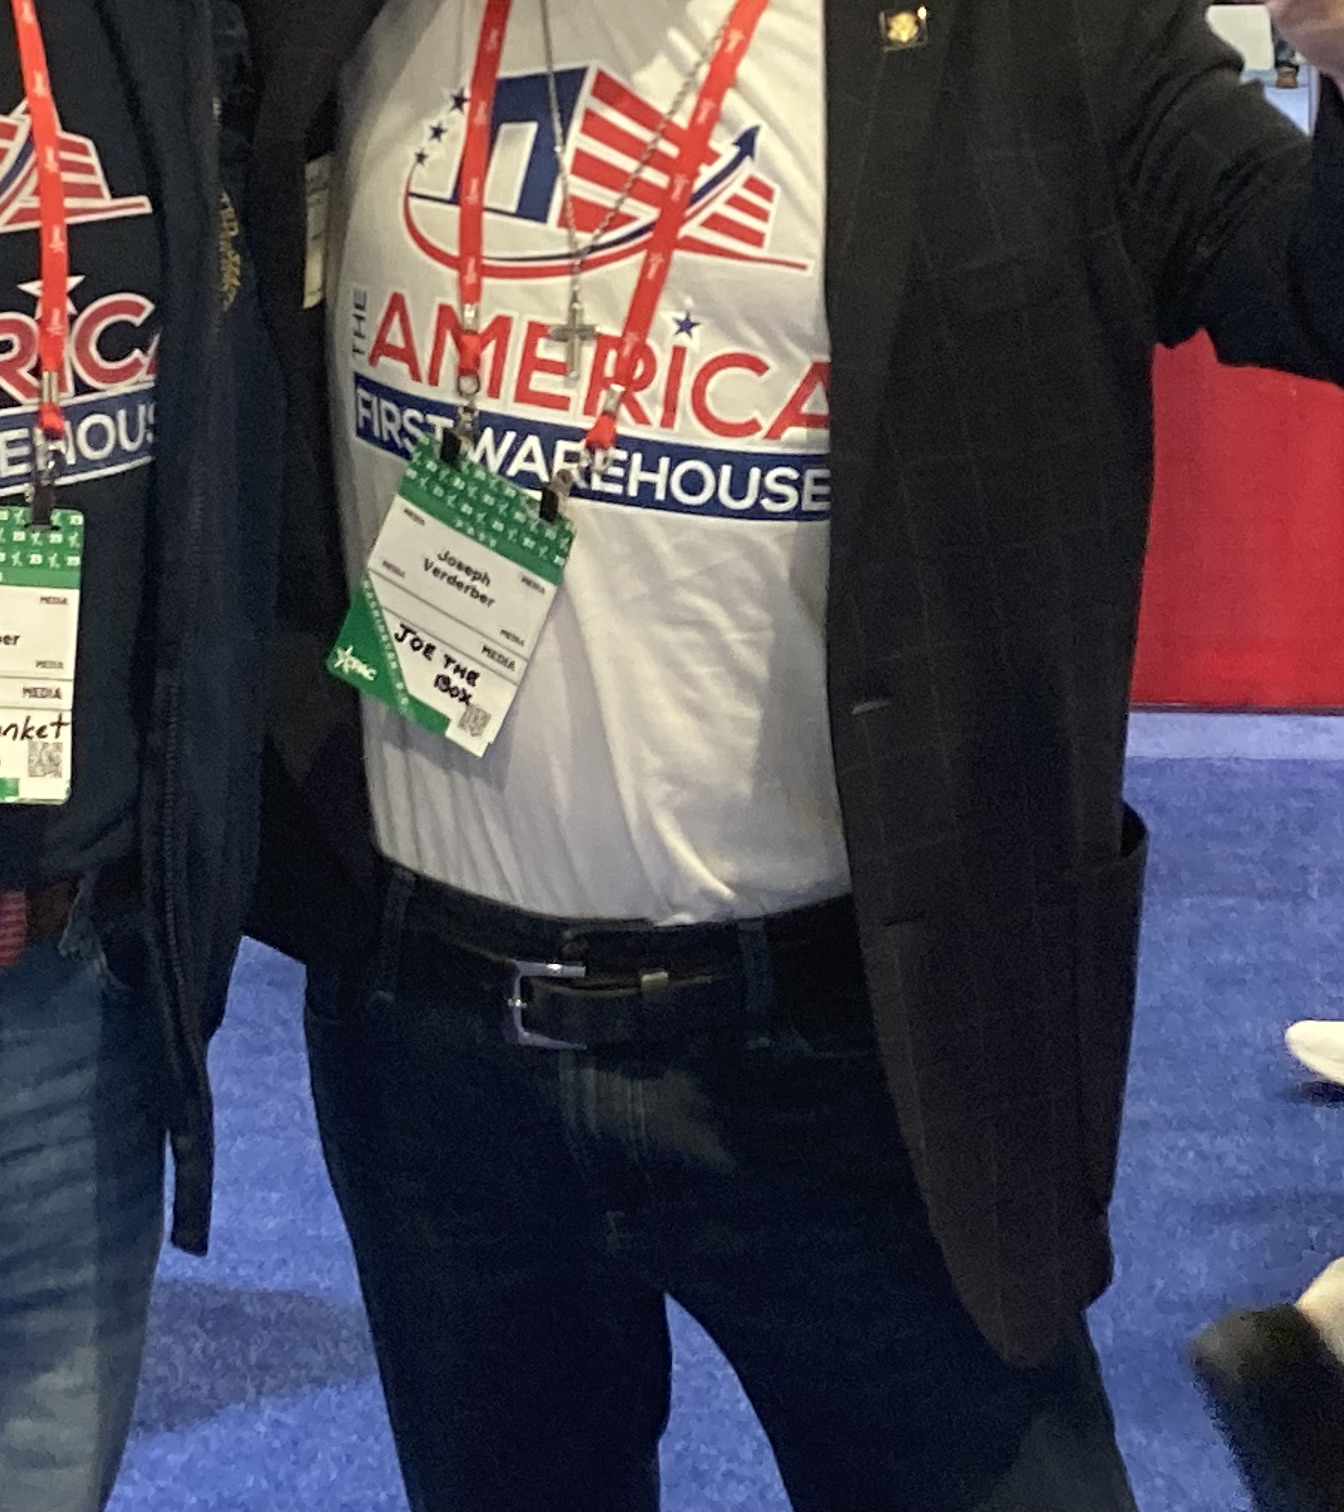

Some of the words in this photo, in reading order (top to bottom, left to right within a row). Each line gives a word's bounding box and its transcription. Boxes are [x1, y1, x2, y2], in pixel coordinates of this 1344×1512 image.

[352, 288, 368, 356] THE
[422, 559, 496, 608] Verderber
[437, 550, 492, 586] Joseph
[393, 623, 439, 661] JOE
[442, 654, 481, 687] THE
